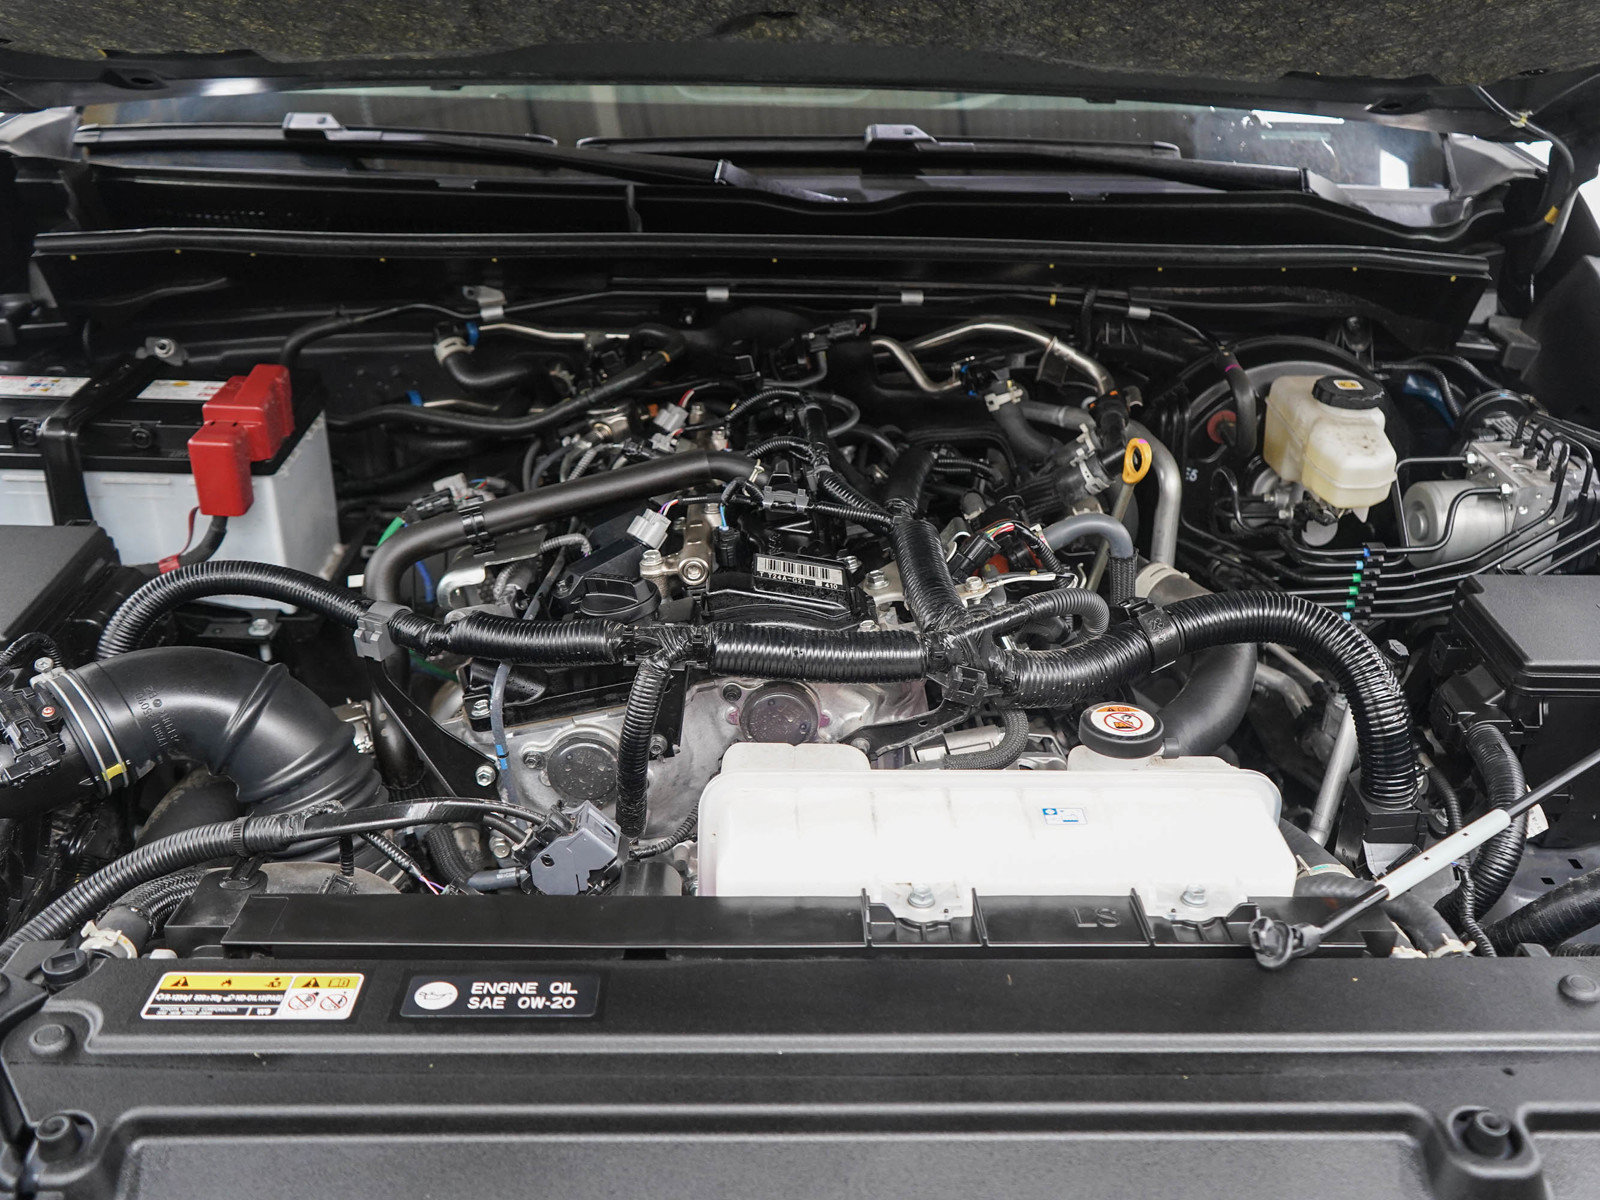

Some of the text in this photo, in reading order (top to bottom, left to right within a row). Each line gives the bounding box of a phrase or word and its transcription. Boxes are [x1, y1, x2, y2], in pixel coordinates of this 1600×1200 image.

[1073, 906, 1121, 928] LS
[470, 981, 578, 995] ENGINE OIL
[467, 996, 576, 1010] SAE 0W-20
